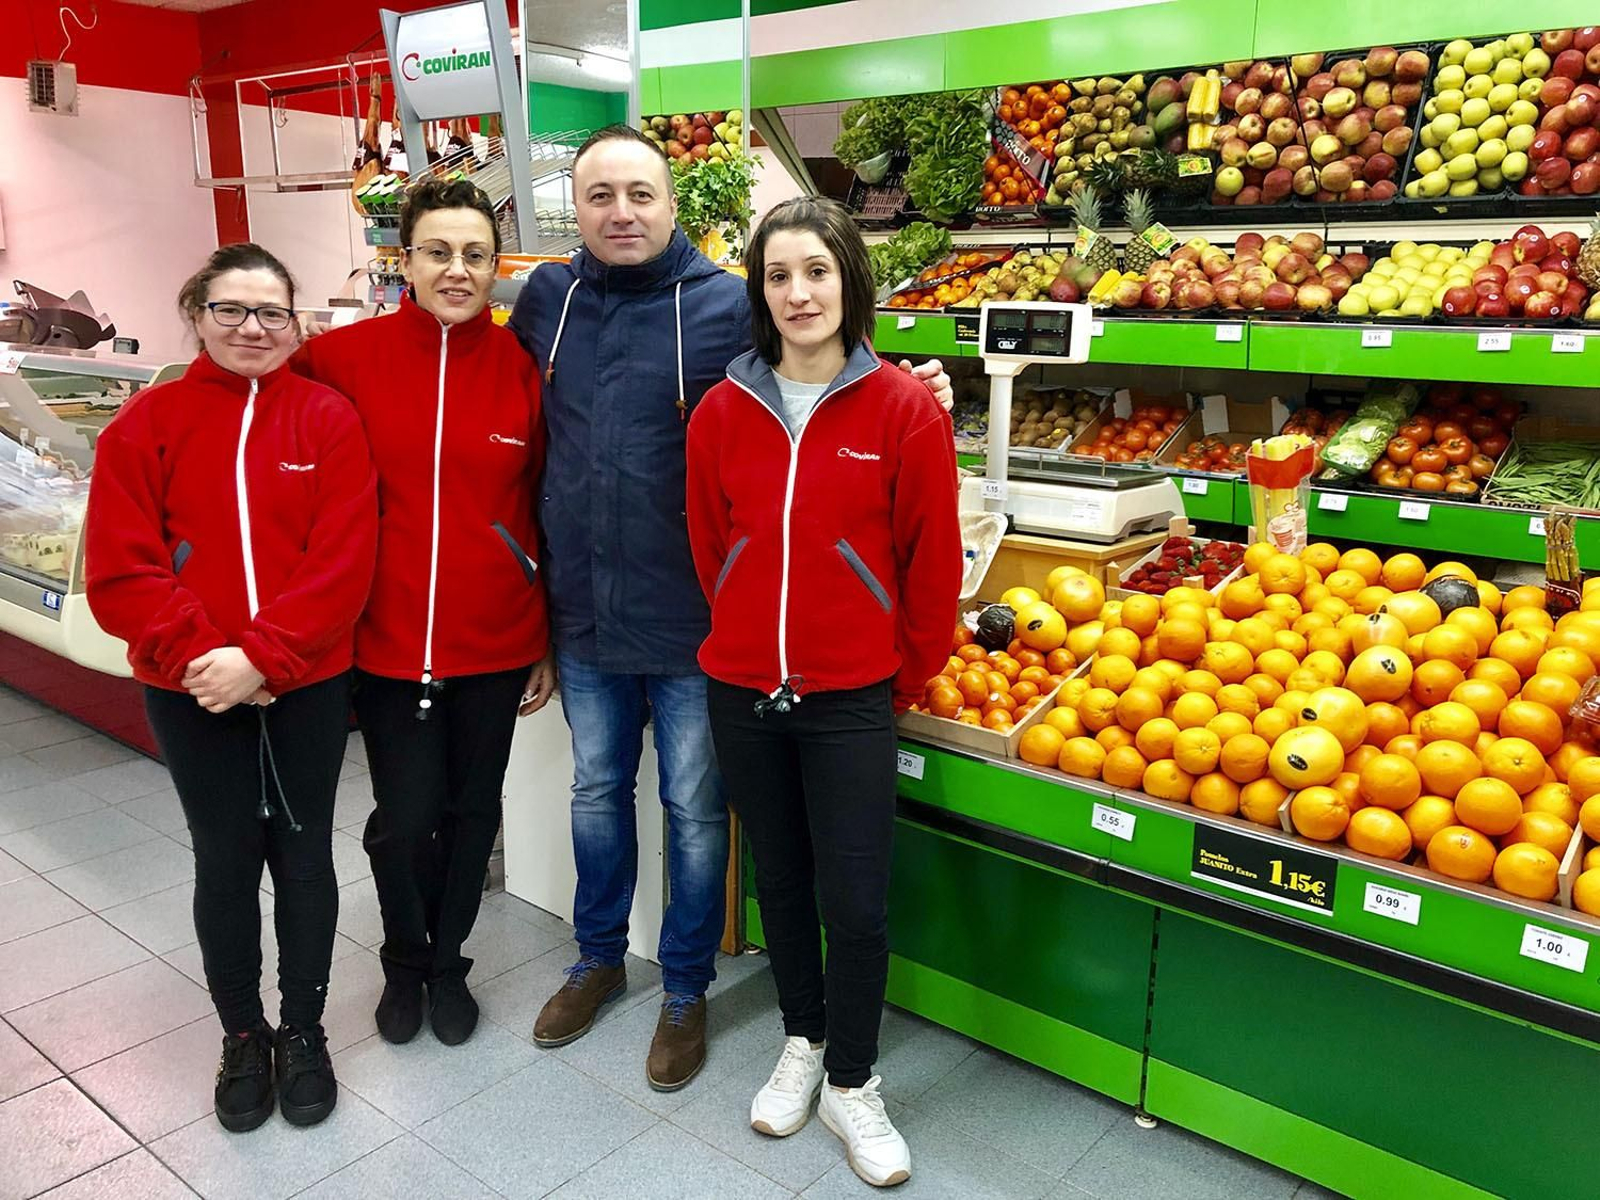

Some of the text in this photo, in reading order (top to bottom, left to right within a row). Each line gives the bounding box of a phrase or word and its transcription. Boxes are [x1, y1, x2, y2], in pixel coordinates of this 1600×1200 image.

[423, 48, 491, 75] COVIRAN
[1101, 813, 1120, 827] 0.55
[1199, 857, 1258, 880] JUANITO Extra
[1268, 859, 1326, 898] 1,15€
[1375, 894, 1400, 909] 0.99
[1536, 938, 1563, 955] 1.00
